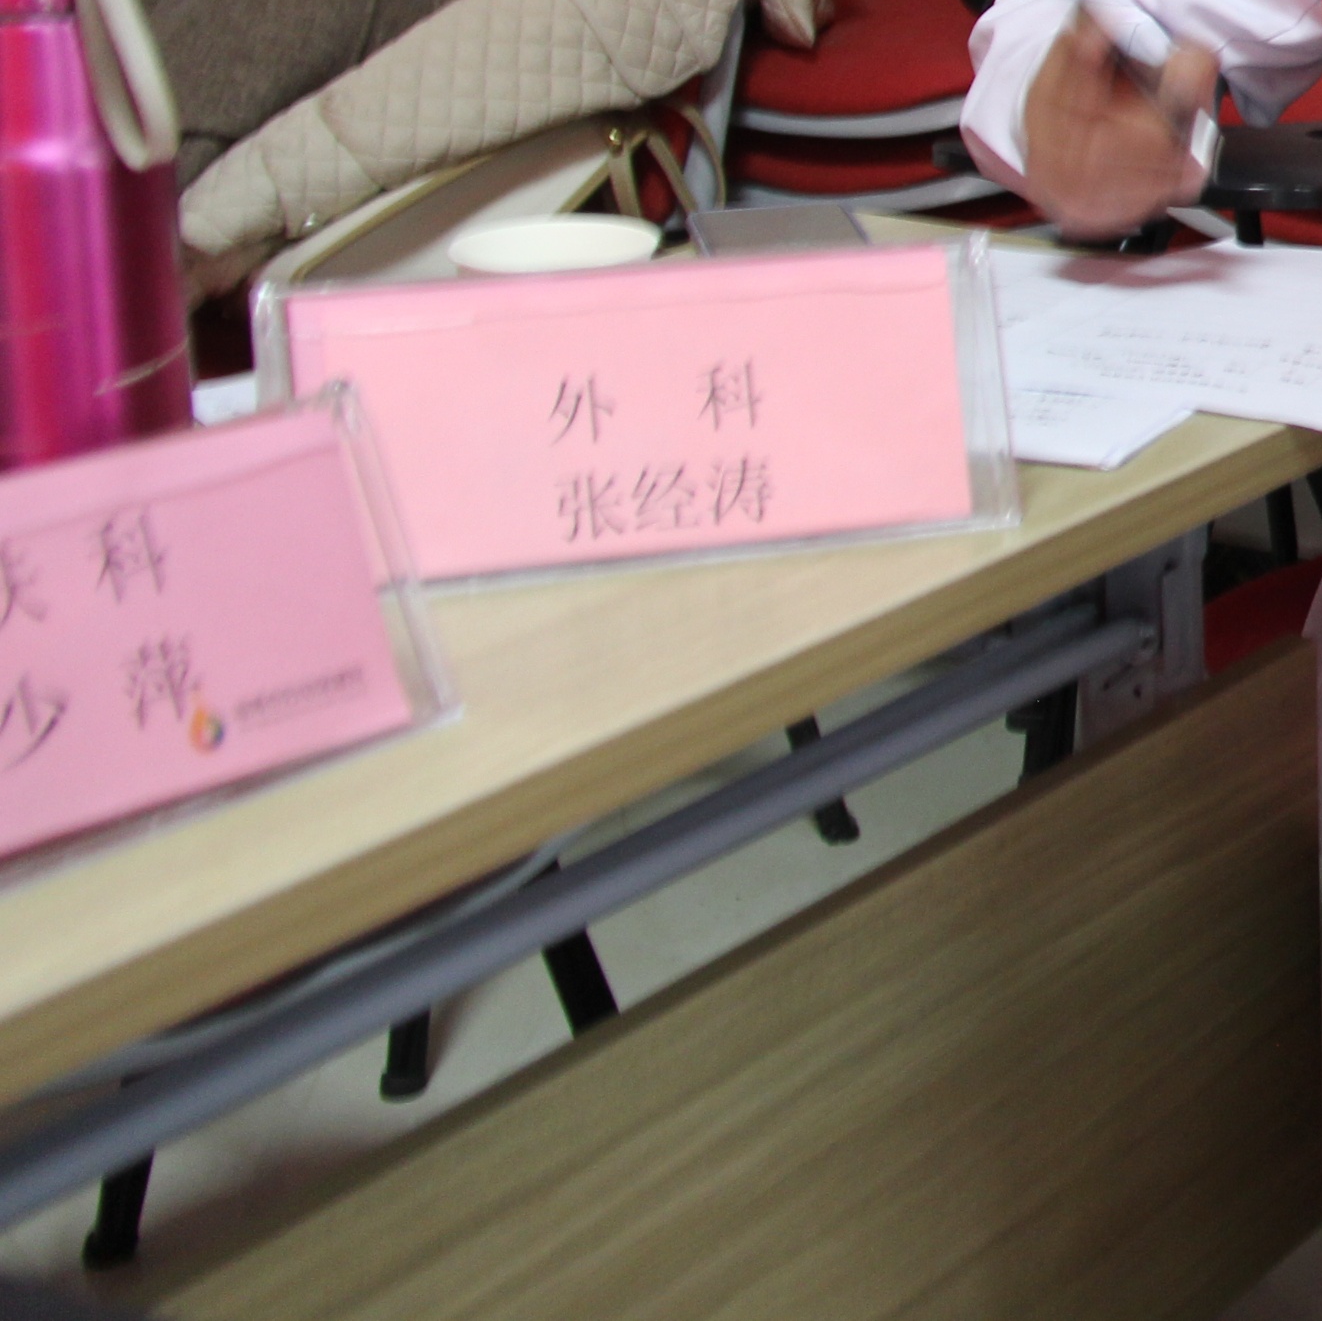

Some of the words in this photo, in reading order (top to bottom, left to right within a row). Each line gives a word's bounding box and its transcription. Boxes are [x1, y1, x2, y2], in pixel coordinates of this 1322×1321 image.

[549, 360, 763, 444] 外科
[556, 457, 772, 541] 张经涛
